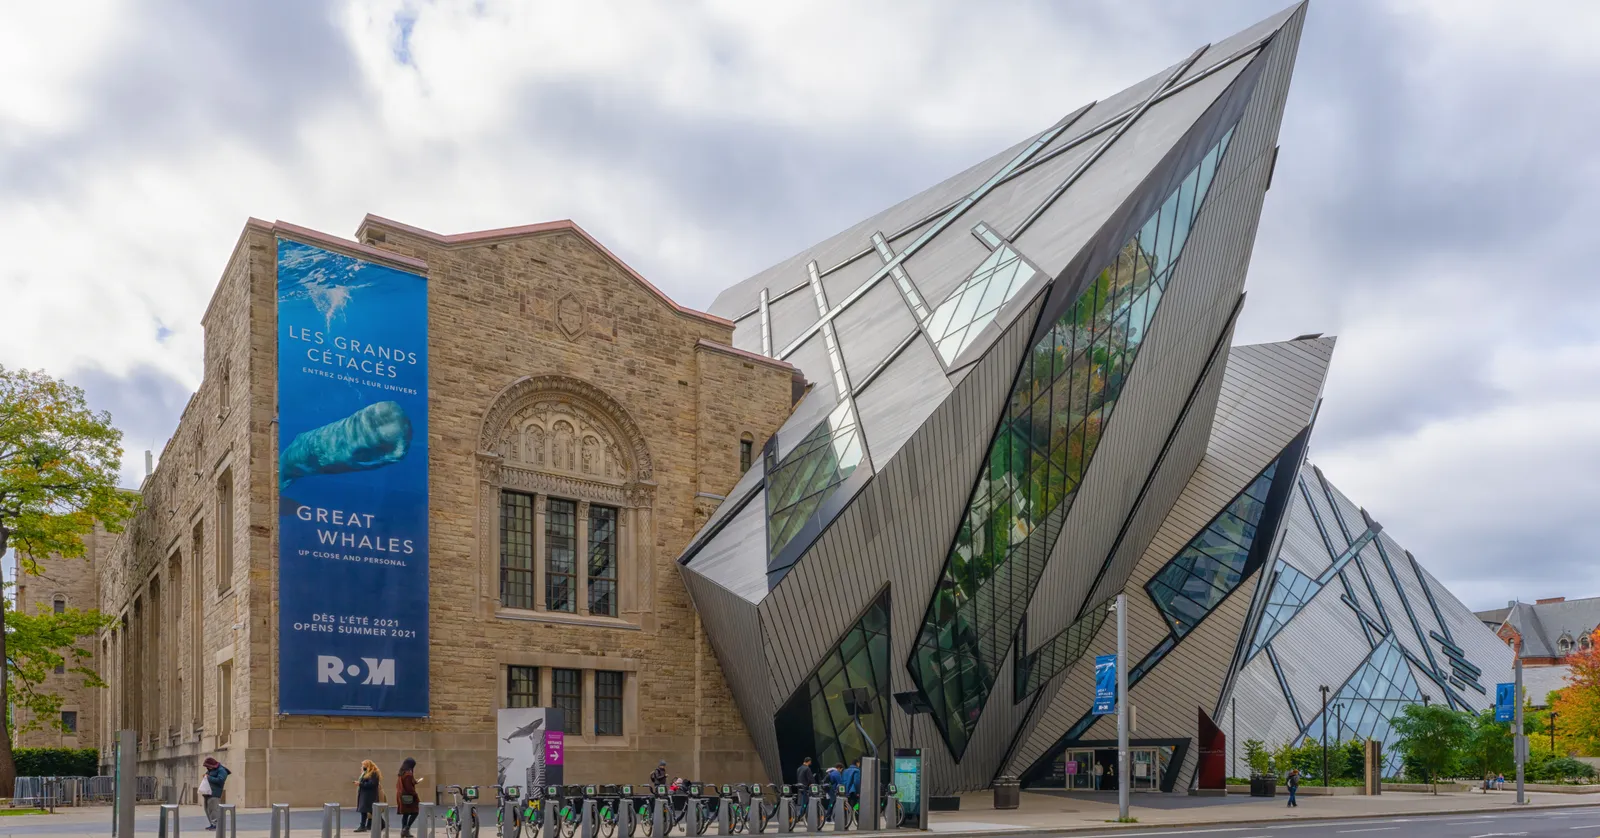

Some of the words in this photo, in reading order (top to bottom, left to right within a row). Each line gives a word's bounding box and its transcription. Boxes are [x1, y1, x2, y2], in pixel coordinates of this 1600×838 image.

[289, 325, 324, 345] LES
[334, 336, 417, 365] GRANDS
[307, 348, 397, 378] CÉTACÉS
[302, 367, 335, 379] ENTREZ
[337, 374, 360, 384] DANS
[362, 379, 382, 389] LEUR
[384, 384, 418, 395] UNIVERS
[296, 505, 375, 529] GREAT
[317, 529, 414, 554] WHALES
[313, 551, 340, 560] CLOSE
[343, 555, 361, 563] AND
[364, 557, 407, 567] PERSONAL
[293, 622, 334, 633] OPENS
[338, 625, 387, 636] SUMMER
[391, 629, 416, 638] 2021
[312, 613, 335, 623] DÈS
[373, 618, 400, 627] 2021
